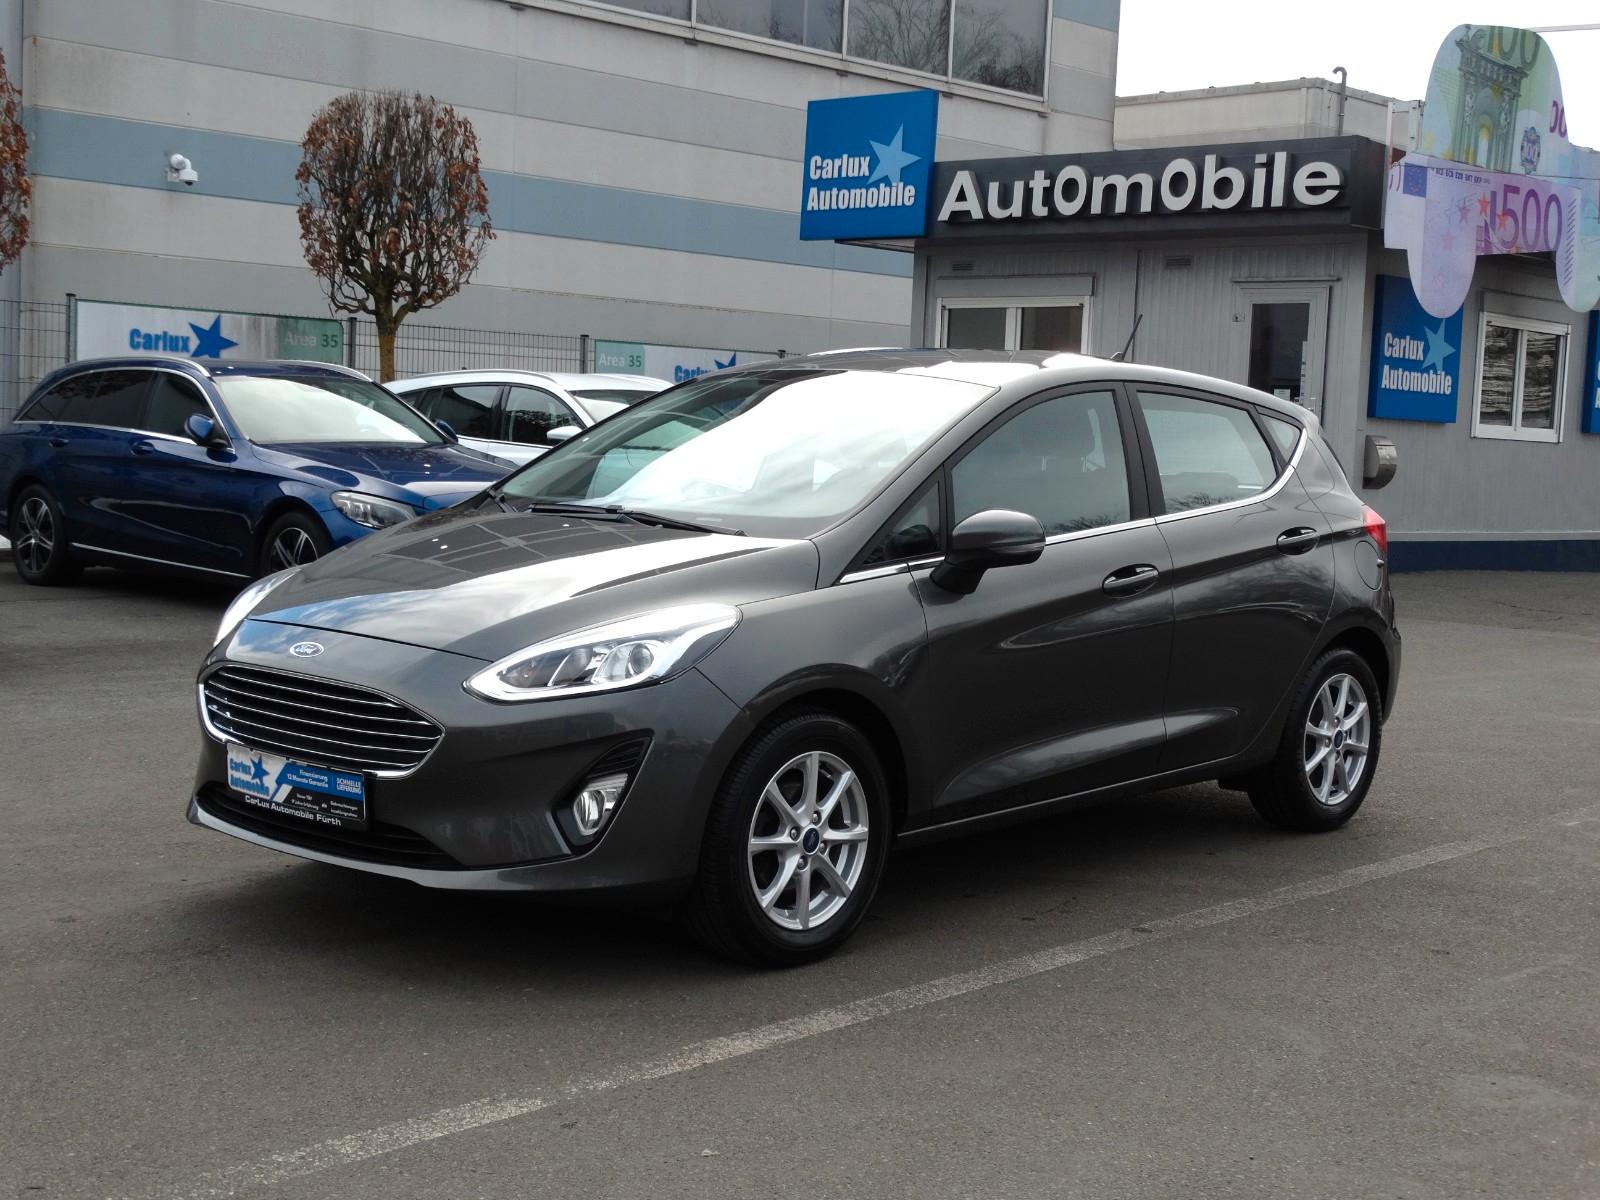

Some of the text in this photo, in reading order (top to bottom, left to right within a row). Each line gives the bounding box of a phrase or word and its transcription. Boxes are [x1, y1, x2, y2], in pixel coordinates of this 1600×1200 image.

[809, 153, 870, 180] Carlux
[806, 182, 916, 211] Automobile
[129, 328, 190, 352] Carlux
[284, 331, 338, 348] Area 35
[1384, 332, 1425, 361] Carlux
[599, 353, 642, 368] Area 35
[1381, 364, 1453, 395] Automobile
[270, 802, 314, 820] Automobile
